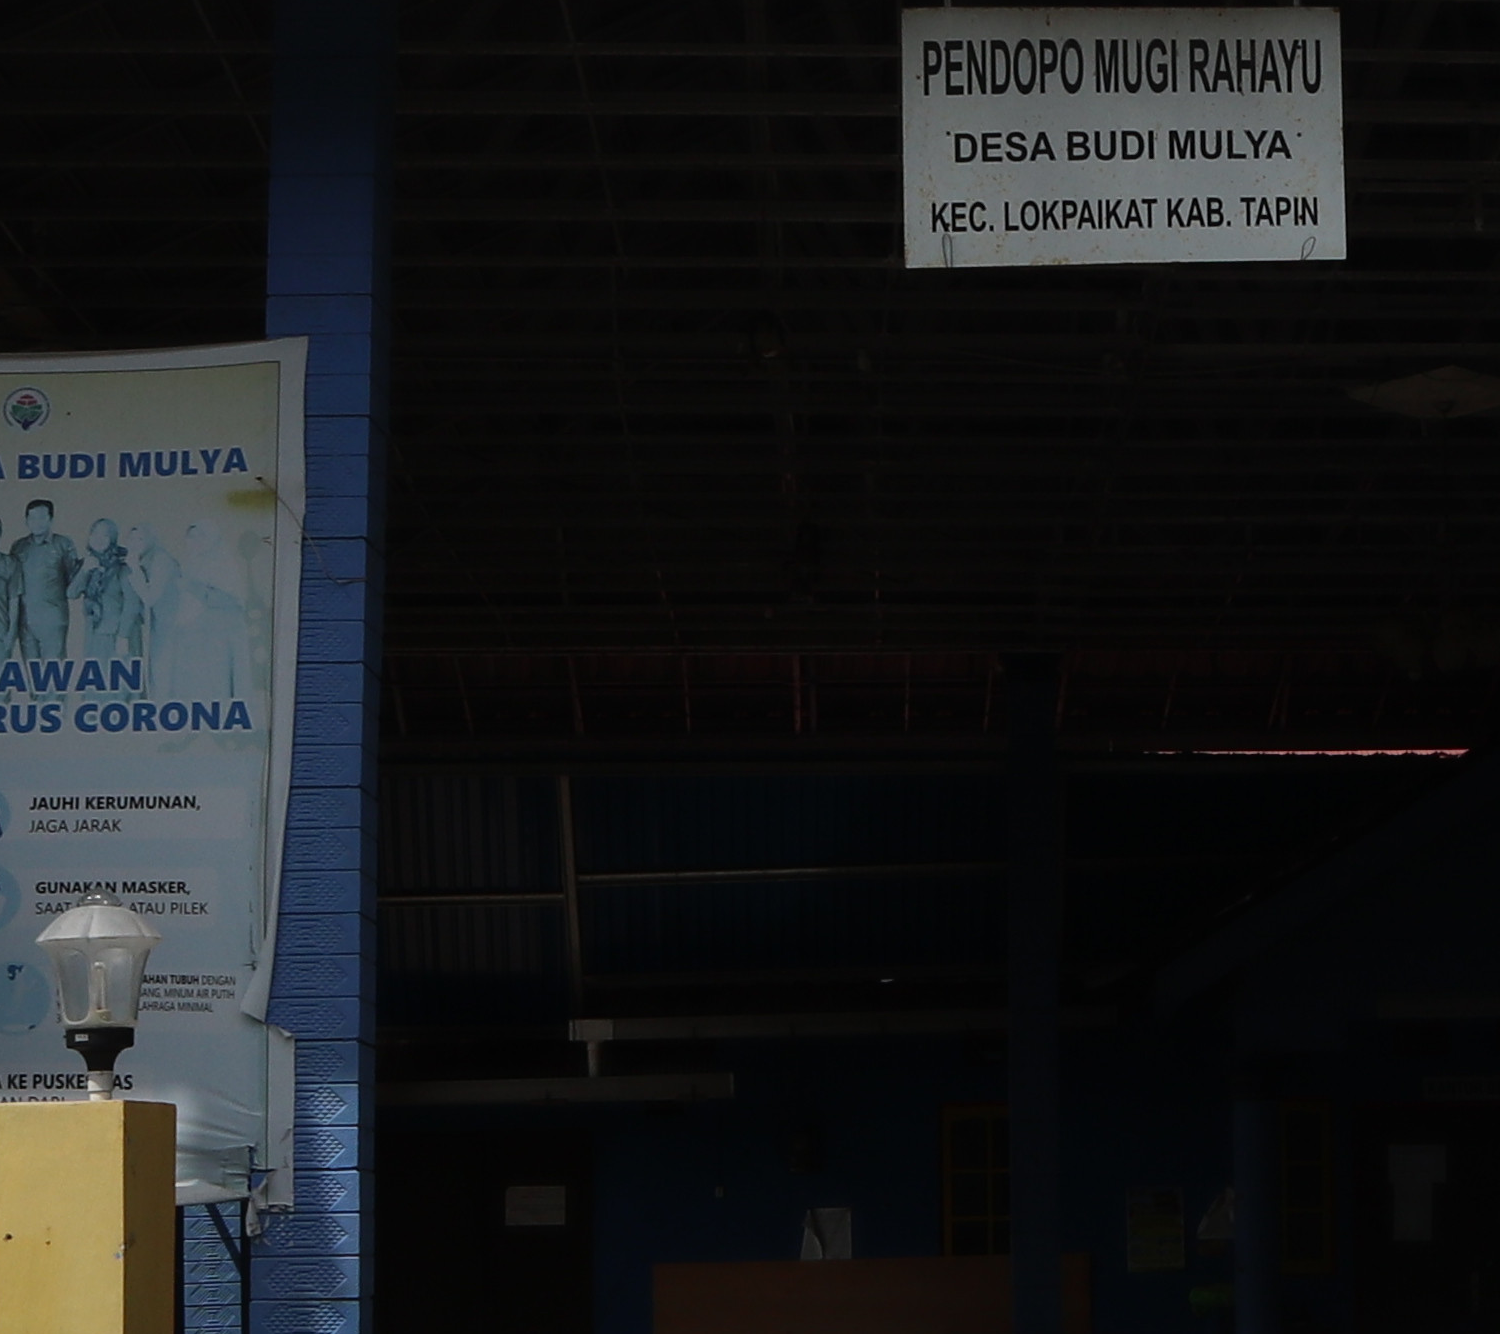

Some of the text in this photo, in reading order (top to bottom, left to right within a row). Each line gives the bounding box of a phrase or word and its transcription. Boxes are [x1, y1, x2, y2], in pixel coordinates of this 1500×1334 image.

[923, 38, 1322, 97] PENDOPO MUGI RAHAYU
[954, 129, 1292, 163] DESA BUDI MULYA
[931, 196, 1319, 233] KEC. LOKPAIKAT KAB. TAPIN
[17, 452, 105, 480] BUDI
[117, 447, 248, 478] MULYA
[74, 701, 253, 735] CORONA
[29, 795, 201, 811] JAUHI KERUMUNAN,
[29, 819, 122, 833] JAGA JARAK
[35, 881, 191, 896] GUNAKAN MASKER,
[35, 902, 209, 915] SAAT ATAU PILEK
[8, 1074, 27, 1090] KE
